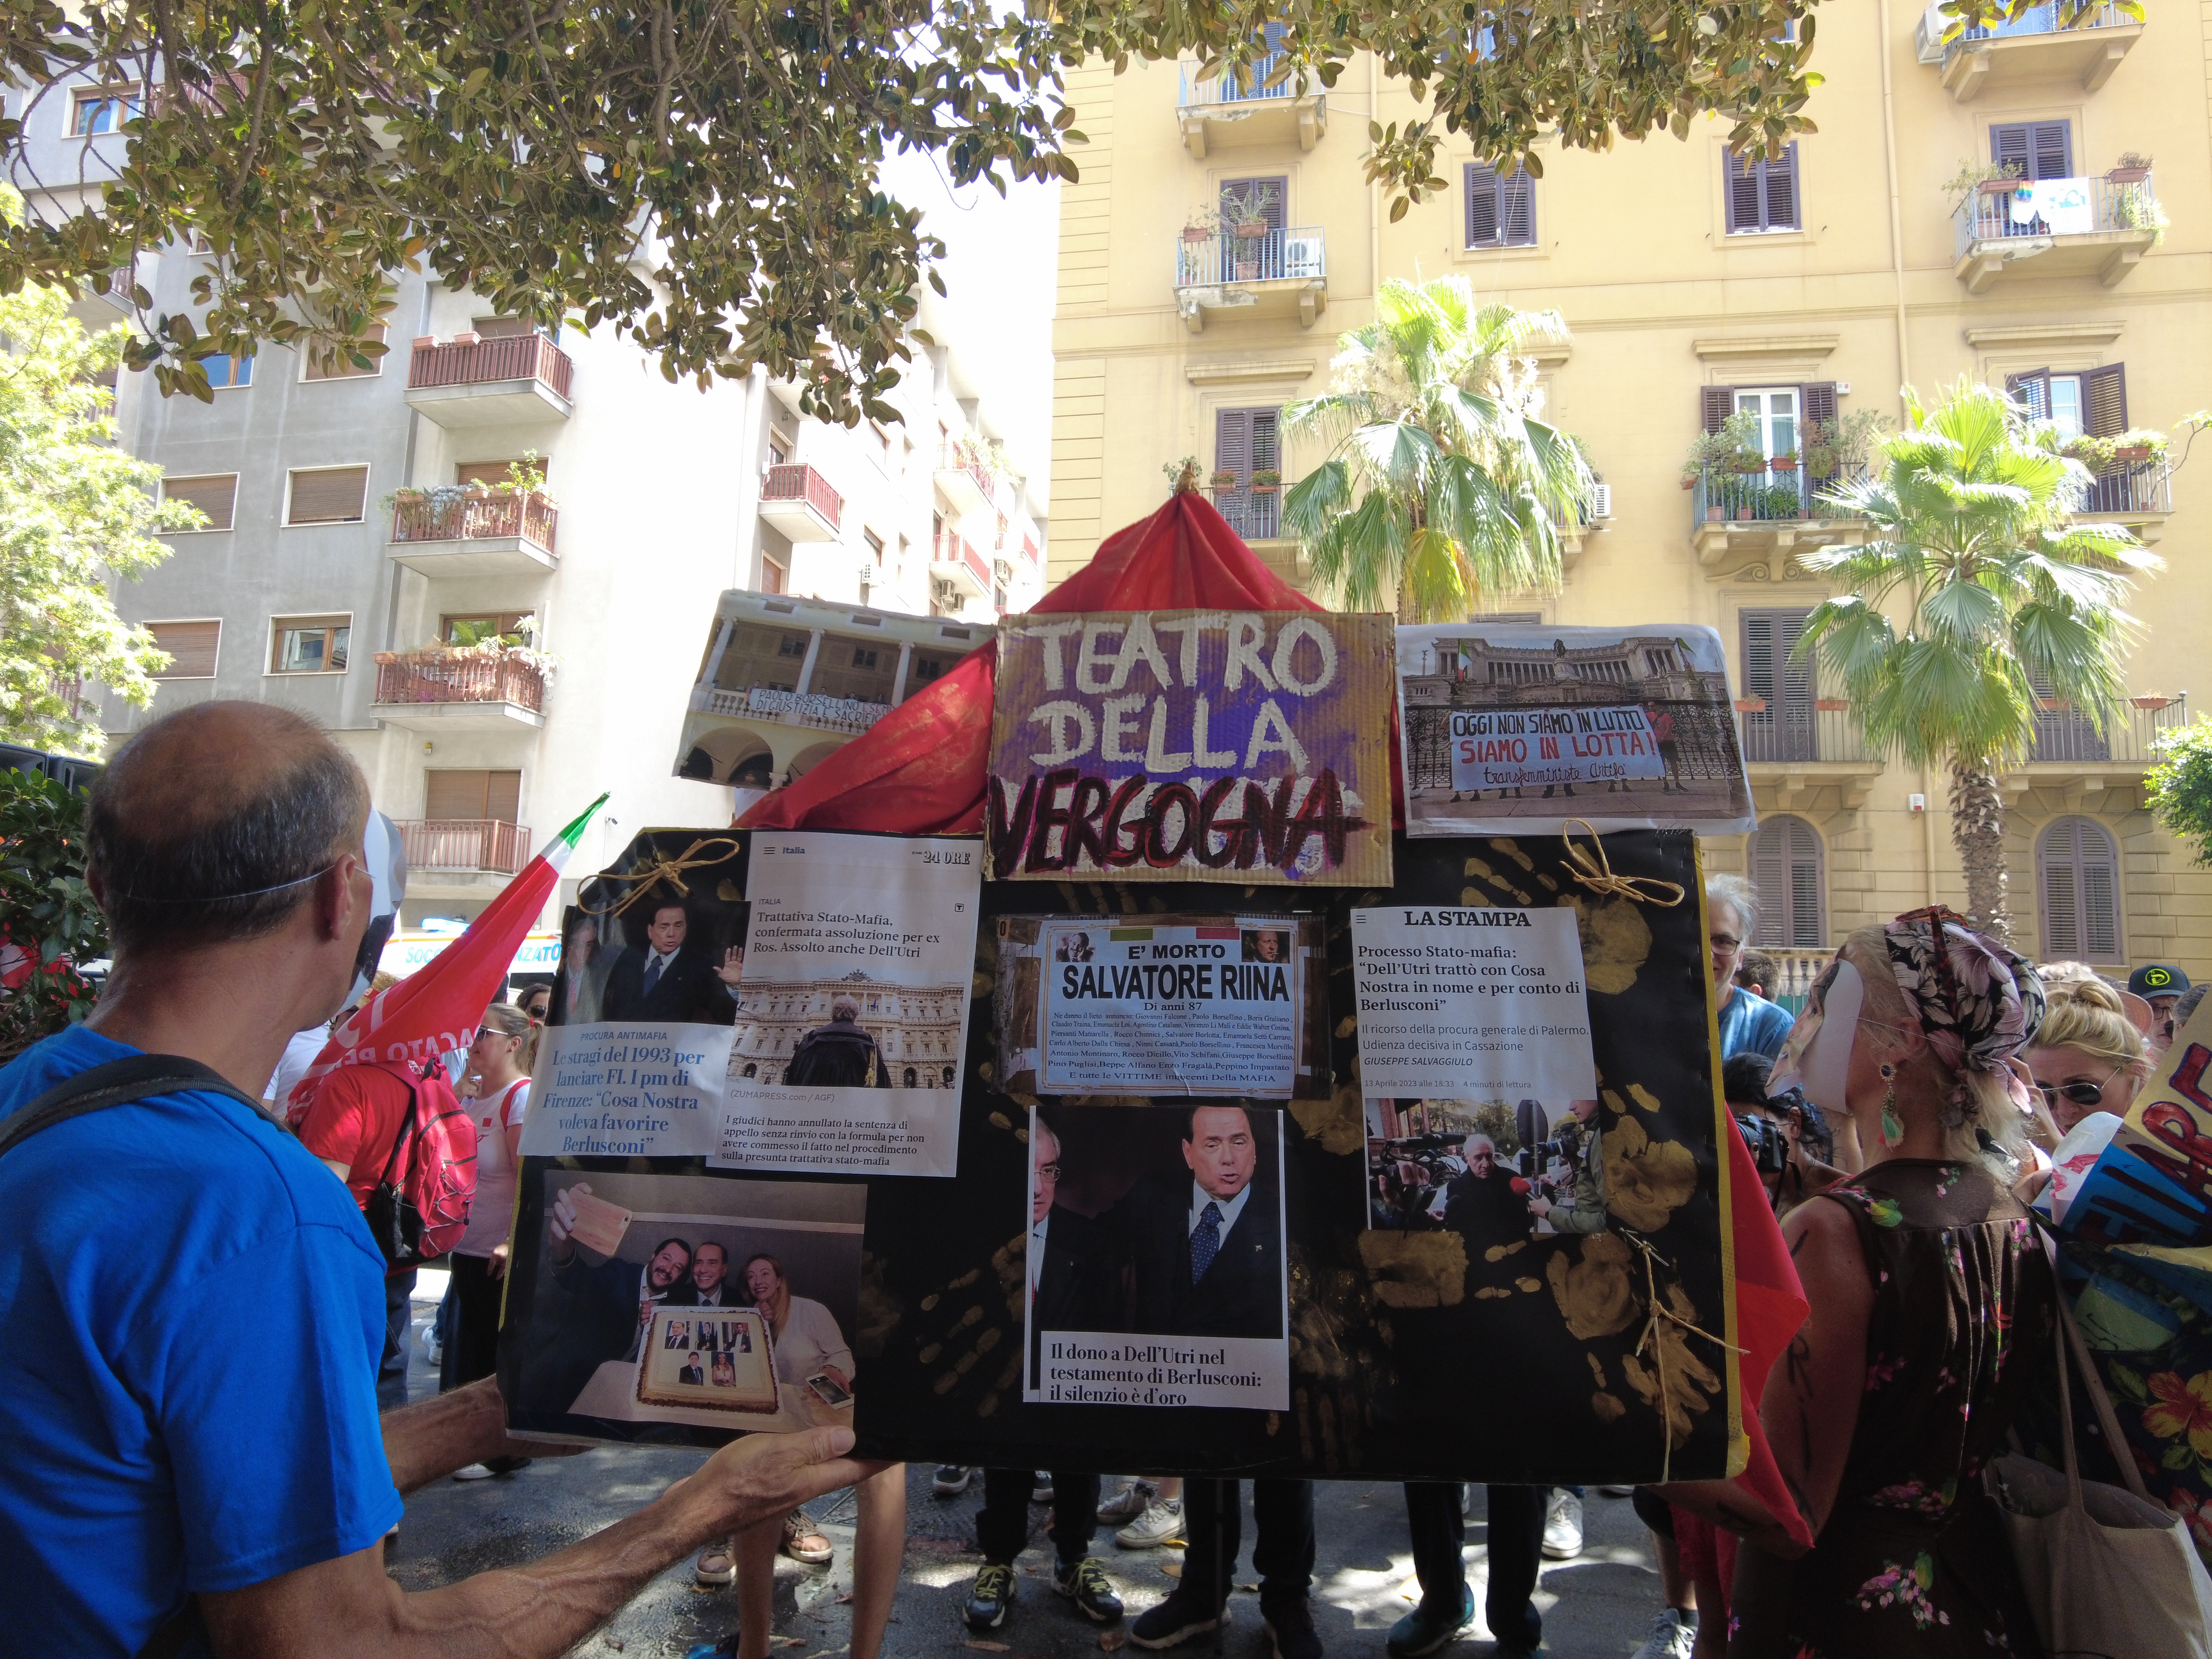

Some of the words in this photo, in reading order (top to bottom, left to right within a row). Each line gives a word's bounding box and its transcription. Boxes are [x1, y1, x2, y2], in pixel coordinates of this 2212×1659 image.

[1025, 613, 1338, 697] TEATRO
[756, 700, 765, 710] DI
[769, 701, 817, 715] GIUSTIZIA
[759, 690, 792, 701] PAOLO
[795, 693, 860, 711] BORSELLINO
[1453, 715, 1492, 737] OGGI
[1498, 714, 1525, 734] NON
[1529, 713, 1573, 733] SIAMO
[1576, 712, 1593, 733] IN
[1596, 710, 1645, 731] LUTTO
[1028, 693, 1310, 774] DELLA
[1460, 738, 1528, 764] SIAMO
[1539, 737, 1560, 760] IN
[989, 768, 1377, 879] VERGOGNA
[923, 851, 940, 864] 24
[942, 852, 971, 865] ORE
[757, 912, 813, 922] Trattativa
[817, 913, 892, 926] Stato-Mafia,
[1404, 912, 1436, 926] LA
[1438, 911, 1531, 926] STAMPA
[756, 926, 822, 937] confermata
[826, 929, 899, 941] assoluzione
[902, 935, 923, 944] per
[406, 947, 443, 963] SOCC
[514, 943, 562, 962] NZATO
[753, 943, 777, 952] Ros.
[780, 942, 824, 952] Assolto
[828, 944, 865, 954] anche
[869, 945, 920, 957] Dell’Utri
[1129, 946, 1145, 959] E’
[1153, 945, 1225, 959] MORTO
[1358, 946, 1421, 957] Processo
[1426, 946, 1516, 958] Stato-mafia:
[1435, 963, 1476, 975] trattò
[1481, 967, 1507, 975] con
[1511, 965, 1546, 976] Cosa
[1062, 964, 1213, 1000] SALVATORE
[1221, 965, 1289, 1001] RIINA
[1360, 982, 1409, 992] Nostra
[1413, 981, 1428, 992] in
[1432, 985, 1473, 993] nome
[1479, 985, 1486, 993] e
[1491, 985, 1515, 996] per
[1519, 984, 1561, 994] conto
[1565, 982, 1580, 993] di
[1161, 1002, 1184, 1010] anni
[581, 1032, 614, 1041] PROCURA
[1362, 1024, 1368, 1034] Il
[1371, 1024, 1407, 1034] ricorso
[1410, 1024, 1435, 1034] della
[1439, 1027, 1478, 1036] procura
[1481, 1026, 1526, 1037] generale
[1529, 1025, 1538, 1035] di
[1542, 1026, 1588, 1035] Palermo.
[1363, 1040, 1405, 1049] Udienza
[1408, 1040, 1449, 1050] decisiva
[1453, 1041, 1461, 1050] in
[1465, 1041, 1523, 1051] Cassazione
[553, 1051, 565, 1065] Le
[568, 1047, 601, 1067] stragi
[604, 1046, 627, 1062] del
[631, 1047, 671, 1062] 1993
[673, 1053, 705, 1067] per
[1411, 1058, 1472, 1066] SALVAGGIULO
[556, 1070, 603, 1086] lanciare
[606, 1069, 626, 1084] FI.
[631, 1070, 637, 1084] I
[639, 1075, 668, 1089] pm
[672, 1070, 688, 1086] di
[1375, 1080, 1397, 1088] Aprile
[542, 1094, 592, 1108] Firenze:
[642, 1093, 697, 1109] Nostra
[731, 1090, 806, 1100] (ZUMAPRESS.com
[814, 1094, 834, 1103] AGF)
[560, 1114, 597, 1129] voleva
[601, 1113, 668, 1131] favorire
[732, 1116, 765, 1125] giudici
[724, 1129, 758, 1137] appello
[790, 1130, 817, 1139] rinvio
[849, 1131, 885, 1141] formula
[802, 1142, 807, 1150] il
[810, 1142, 832, 1151] fatto
[835, 1143, 849, 1152] nel
[852, 1145, 916, 1154] procedimento
[721, 1152, 743, 1160] sulla
[790, 1155, 832, 1163] trattativa
[835, 1157, 889, 1165] stato-mafia
[1051, 1343, 1063, 1358] Il
[1067, 1344, 1107, 1360] dono
[1111, 1350, 1120, 1360] a
[1124, 1346, 1195, 1363] Dell’Utri
[1199, 1349, 1225, 1364] nel
[1051, 1367, 1143, 1382] testamento
[1147, 1368, 1163, 1383] di
[1167, 1369, 1261, 1386] Berlusconi:
[1050, 1384, 1060, 1400] il
[1065, 1385, 1127, 1404] silenzio
[1131, 1388, 1140, 1403] è
[1144, 1388, 1187, 1406] d’oro
